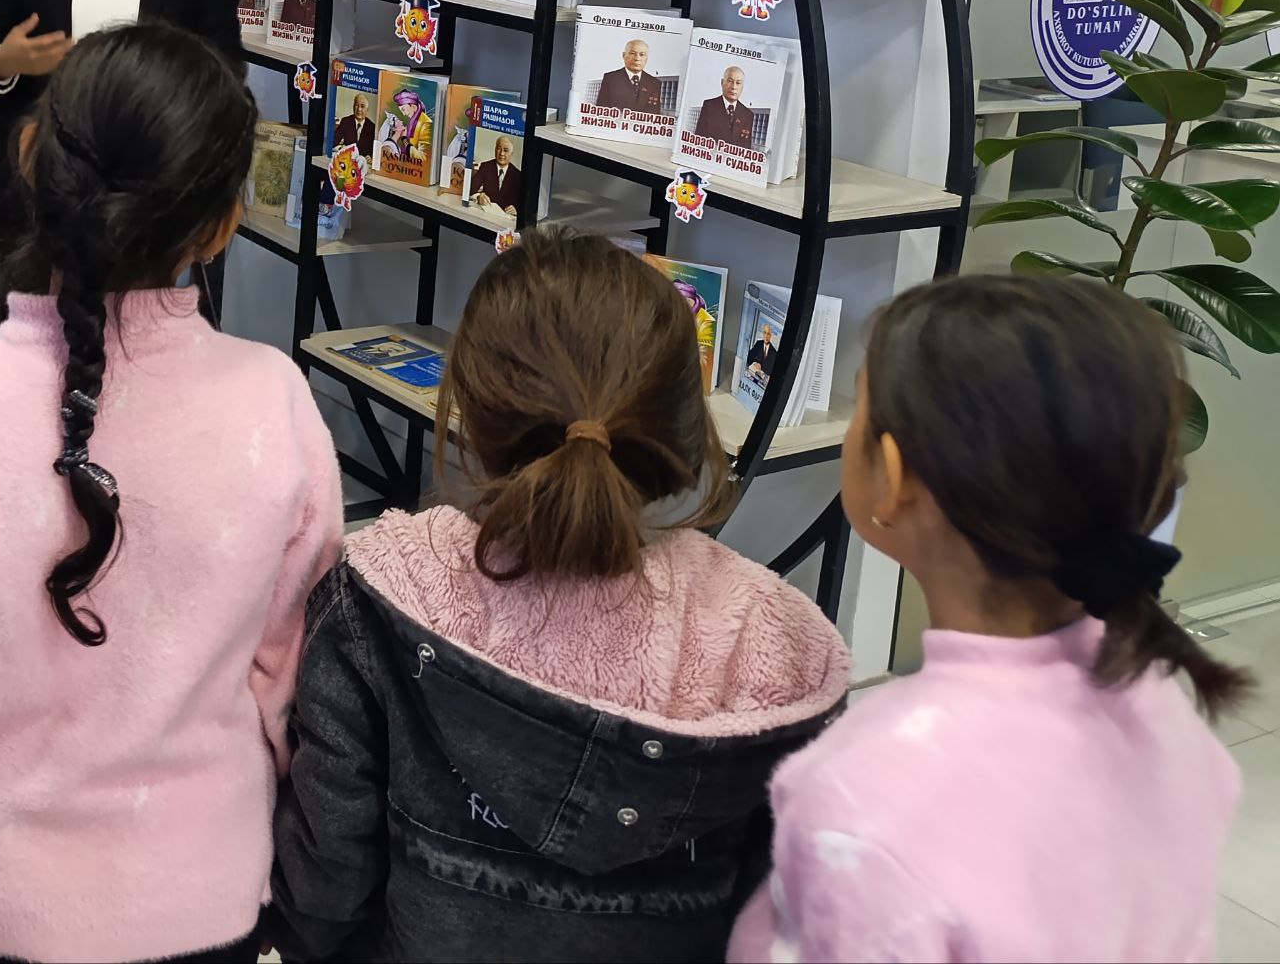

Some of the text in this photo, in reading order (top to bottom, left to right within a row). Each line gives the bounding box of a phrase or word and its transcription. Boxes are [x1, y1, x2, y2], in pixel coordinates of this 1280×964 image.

[593, 14, 666, 32] Федор Раззаков
[1076, 21, 1121, 35] TUMAN
[1053, 10, 1074, 57] AXBOROT
[698, 37, 762, 59] Федор Раззаков
[484, 105, 508, 115] ШАРАФ
[580, 102, 619, 118] Шараф
[581, 116, 673, 137] жизнь и судьба
[681, 130, 715, 150] Шараф
[383, 150, 422, 167] KASHMIR
[681, 144, 762, 175] жизнь и судьба
